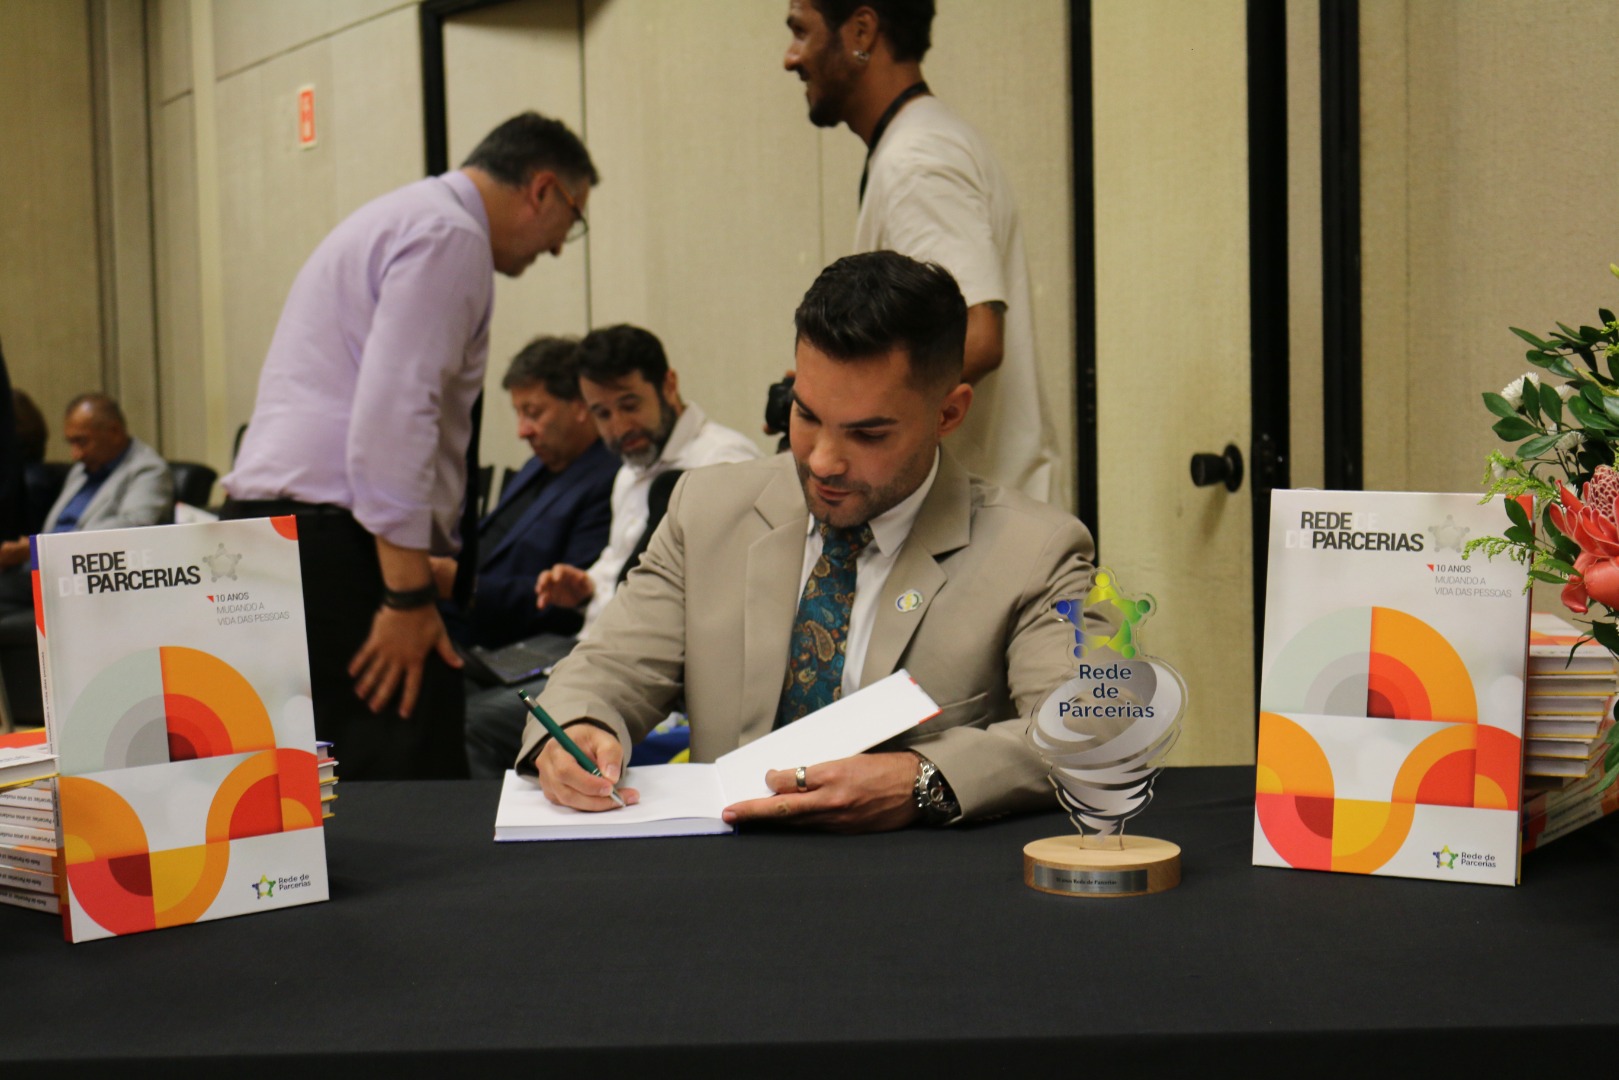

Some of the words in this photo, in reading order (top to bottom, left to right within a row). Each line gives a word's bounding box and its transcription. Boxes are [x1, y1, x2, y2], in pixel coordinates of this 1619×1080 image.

[1300, 511, 1352, 530] REDE
[1312, 531, 1424, 552] PARCERIAS
[71, 551, 127, 574] REDE
[1437, 564, 1446, 572] 10
[1447, 565, 1471, 573] ANOS
[87, 565, 201, 594] PARCERIAS
[1435, 575, 1479, 585] MUDANDO
[1479, 577, 1486, 585] A
[216, 594, 226, 602] 10
[227, 592, 249, 601] ANOS
[1434, 587, 1454, 596] VIDA
[1455, 588, 1472, 596] DAS
[1473, 588, 1512, 598] PESSOAS
[216, 602, 258, 614] MUDANDO
[258, 602, 265, 610] A
[217, 616, 237, 626] VIDA
[237, 614, 254, 624] DAS
[254, 611, 290, 622] PESSOAS
[1079, 664, 1132, 680] Rede
[1092, 682, 1119, 699] de
[1059, 702, 1155, 718] Parcerias
[1461, 852, 1482, 860] Rede
[1461, 859, 1496, 868] Parcerias
[278, 876, 298, 884] Rede
[279, 880, 311, 890] Parcerias
